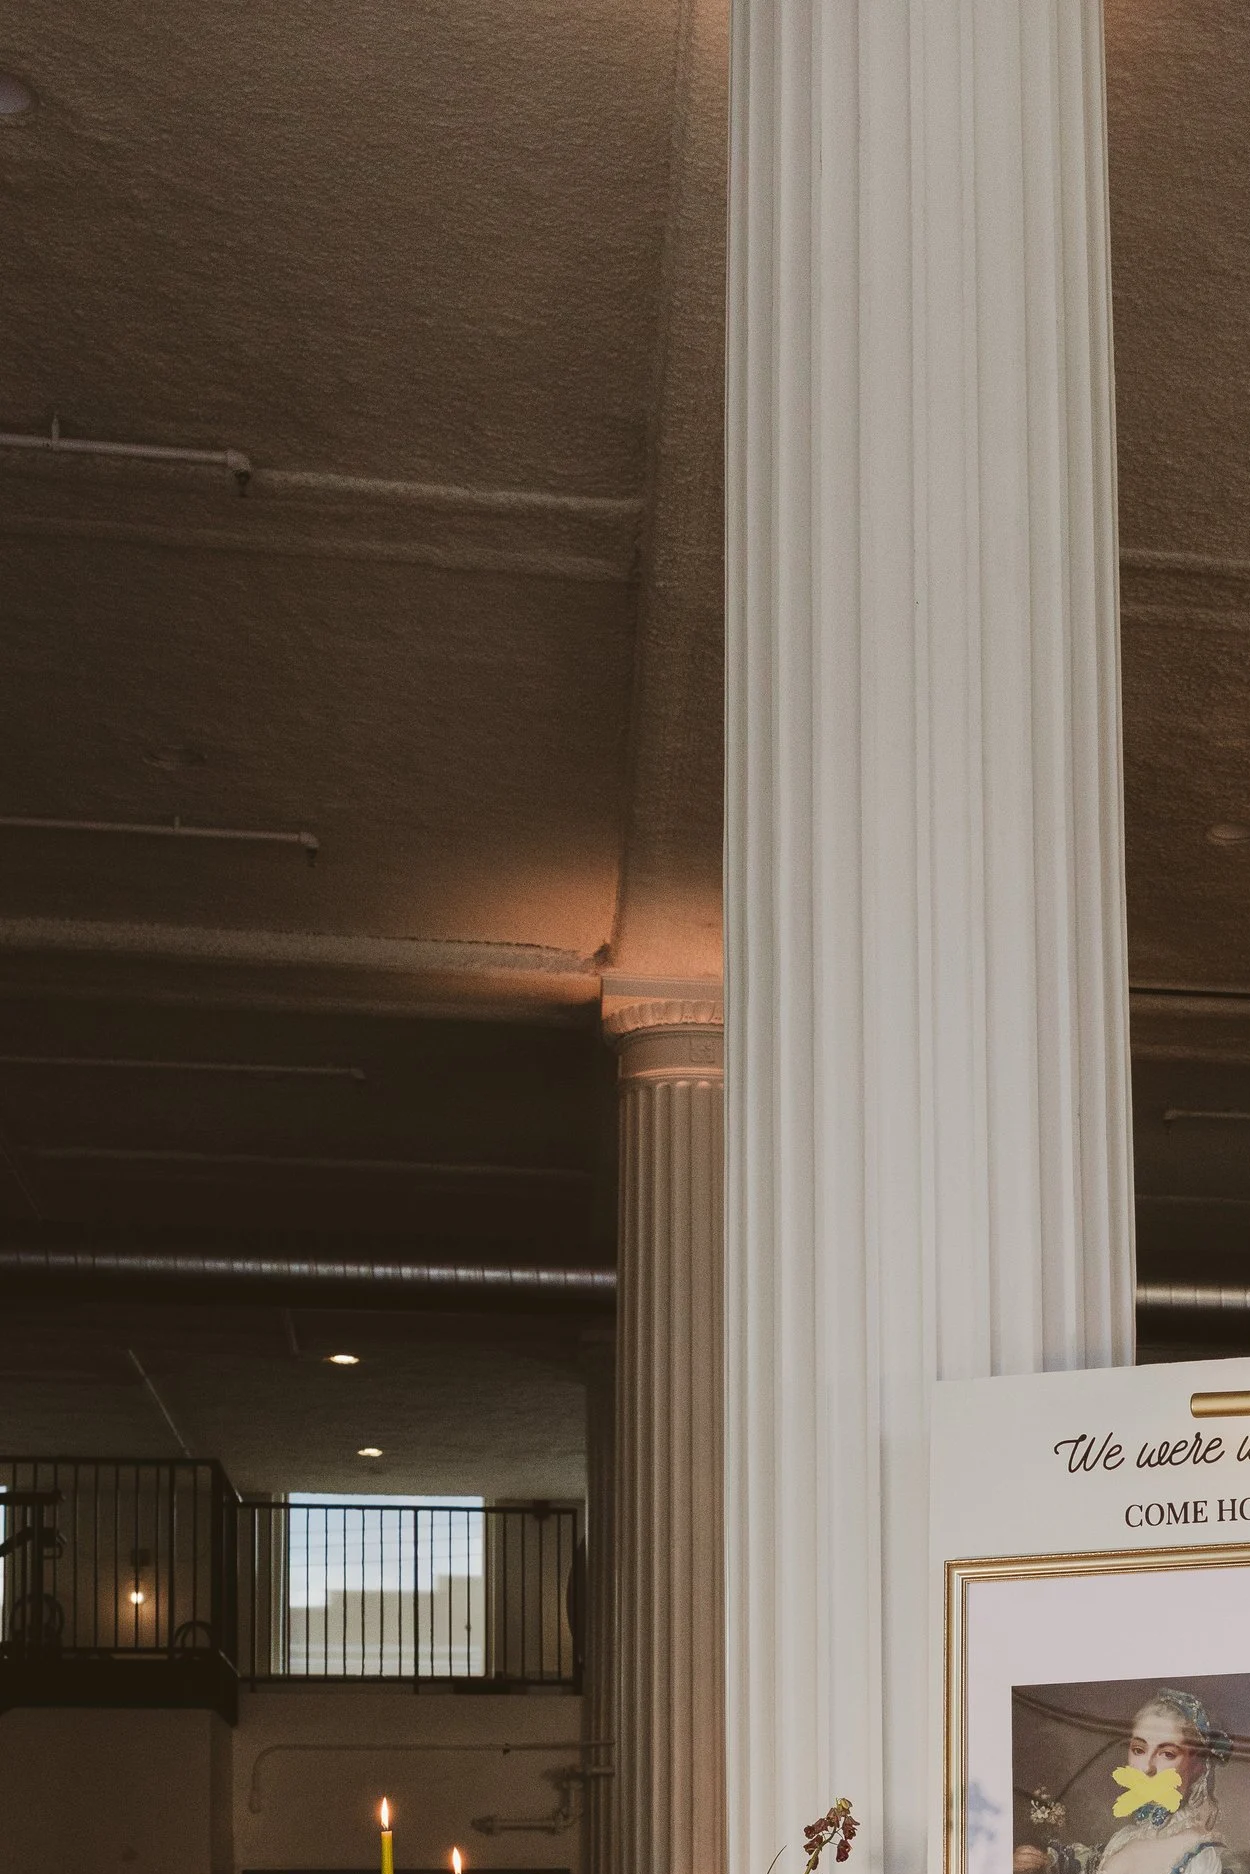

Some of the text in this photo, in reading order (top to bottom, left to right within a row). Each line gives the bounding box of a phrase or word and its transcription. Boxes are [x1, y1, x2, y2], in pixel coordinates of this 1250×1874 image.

[1053, 1431, 1126, 1474] We
[1136, 1431, 1226, 1469] were
[1124, 1501, 1209, 1528] COME
